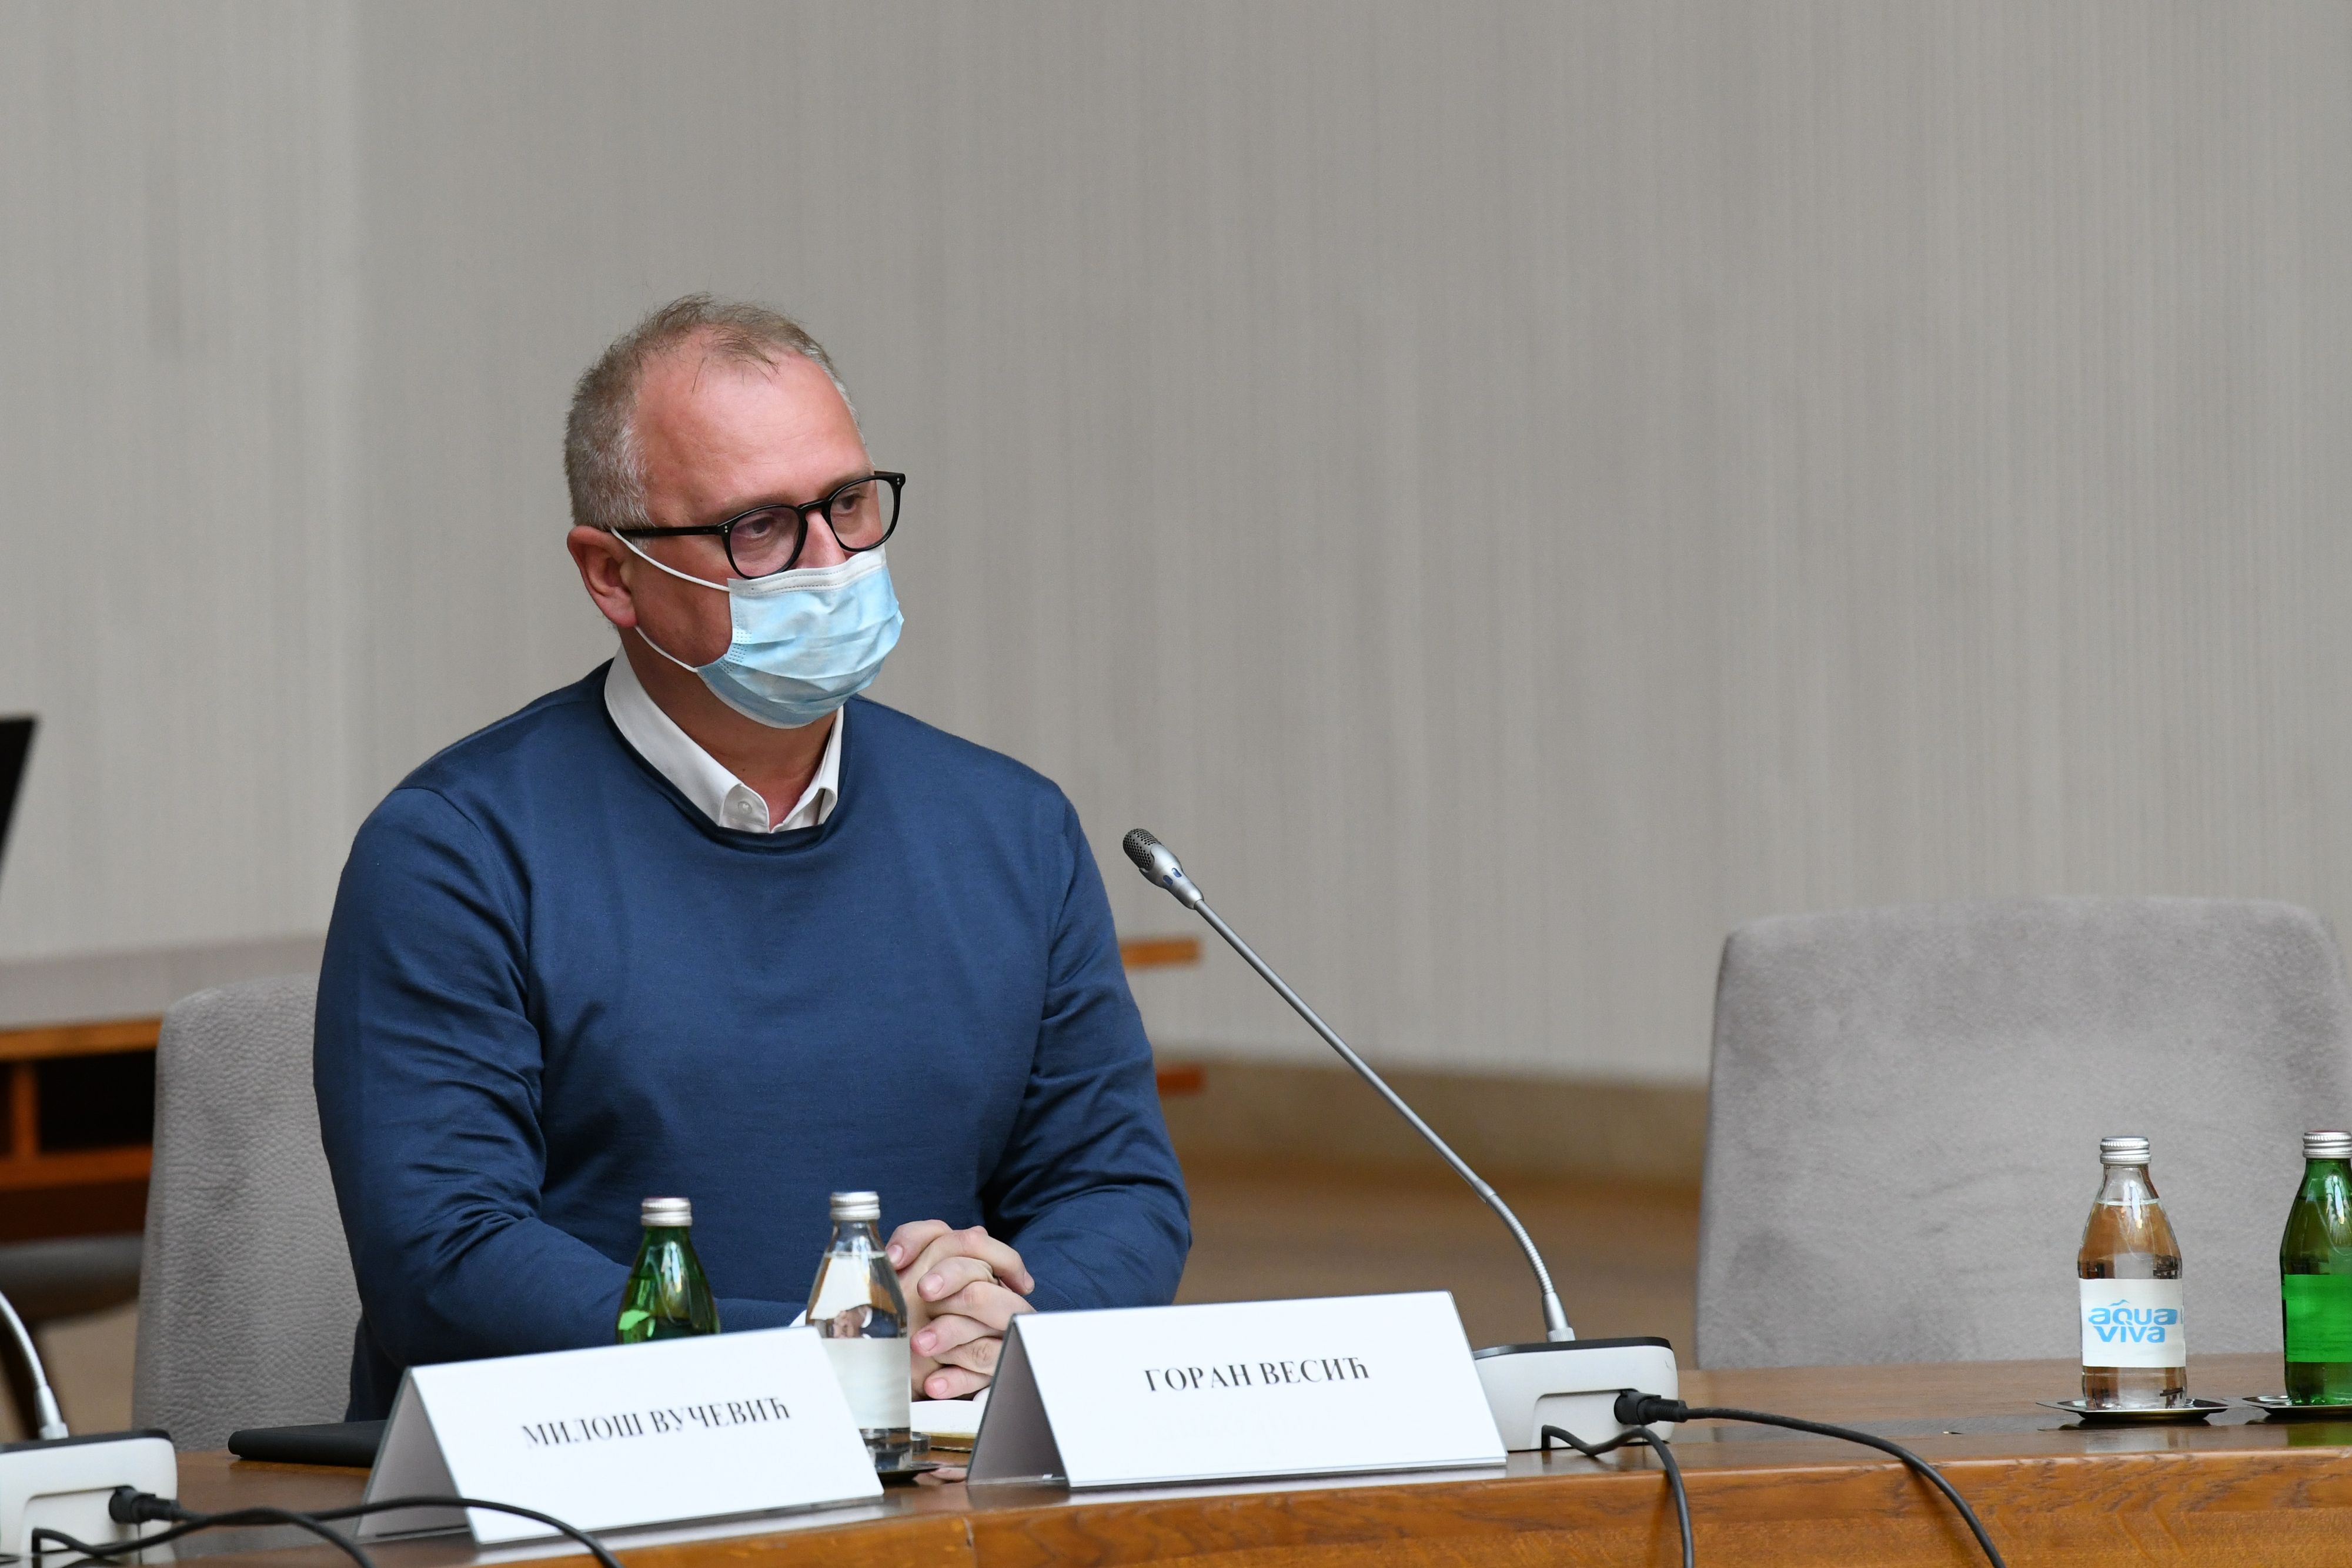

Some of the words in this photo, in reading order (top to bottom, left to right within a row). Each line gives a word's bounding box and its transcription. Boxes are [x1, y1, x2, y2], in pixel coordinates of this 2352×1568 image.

[2088, 1306, 2177, 1326] aqua
[2094, 1325, 2166, 1343] viva
[1144, 1363, 1252, 1392] ГОРАН
[1258, 1357, 1370, 1385] ВЕСИЋ
[522, 1412, 644, 1447] МИЛОШ
[649, 1397, 790, 1433] ВУЧЕВИЋ
